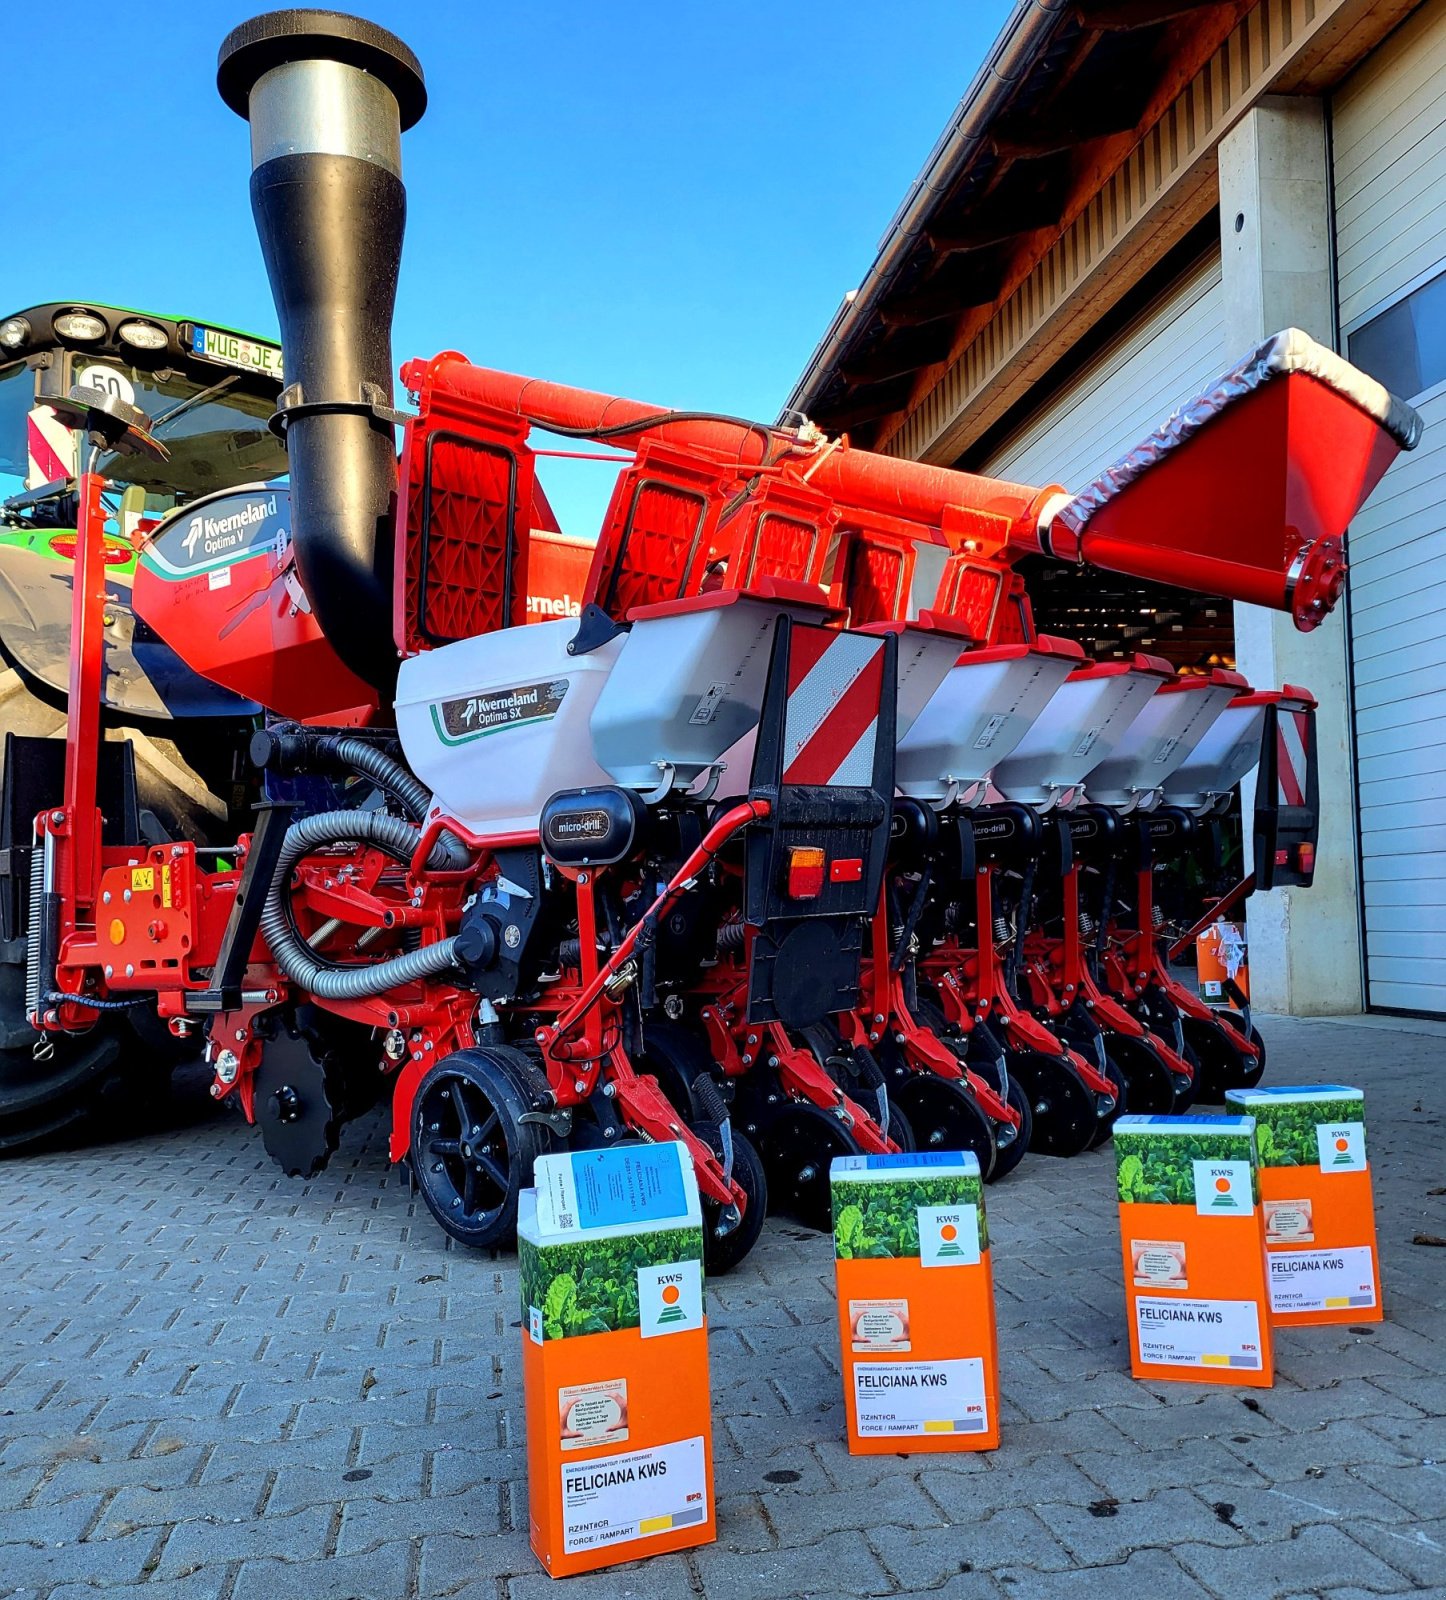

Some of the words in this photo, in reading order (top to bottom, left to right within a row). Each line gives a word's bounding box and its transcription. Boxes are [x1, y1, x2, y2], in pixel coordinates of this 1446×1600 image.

[206, 331, 238, 359] WUG
[252, 346, 272, 369] JE
[92, 374, 121, 400] 50
[204, 495, 277, 539] Kverneland
[204, 536, 236, 554] Optima
[237, 529, 244, 542] V
[478, 689, 538, 712] Kverneland
[479, 712, 508, 725] Optima
[510, 707, 522, 718] SX
[558, 820, 600, 832] micro-drill
[973, 824, 1006, 834] icro-drill
[936, 1215, 960, 1224] KWS
[1272, 1261, 1320, 1272] FELICIANA
[1323, 1259, 1344, 1270] KWS
[657, 1274, 682, 1285] KWS
[1140, 1308, 1195, 1322] FELICIANA
[1197, 1311, 1223, 1323] KWS
[858, 1375, 918, 1387] FELICIANA
[921, 1374, 948, 1386] KWS
[566, 1468, 635, 1493] FELICIANA
[638, 1461, 667, 1480] KWS
[569, 1535, 594, 1546] FORCE
[600, 1527, 634, 1540] RAMPART
